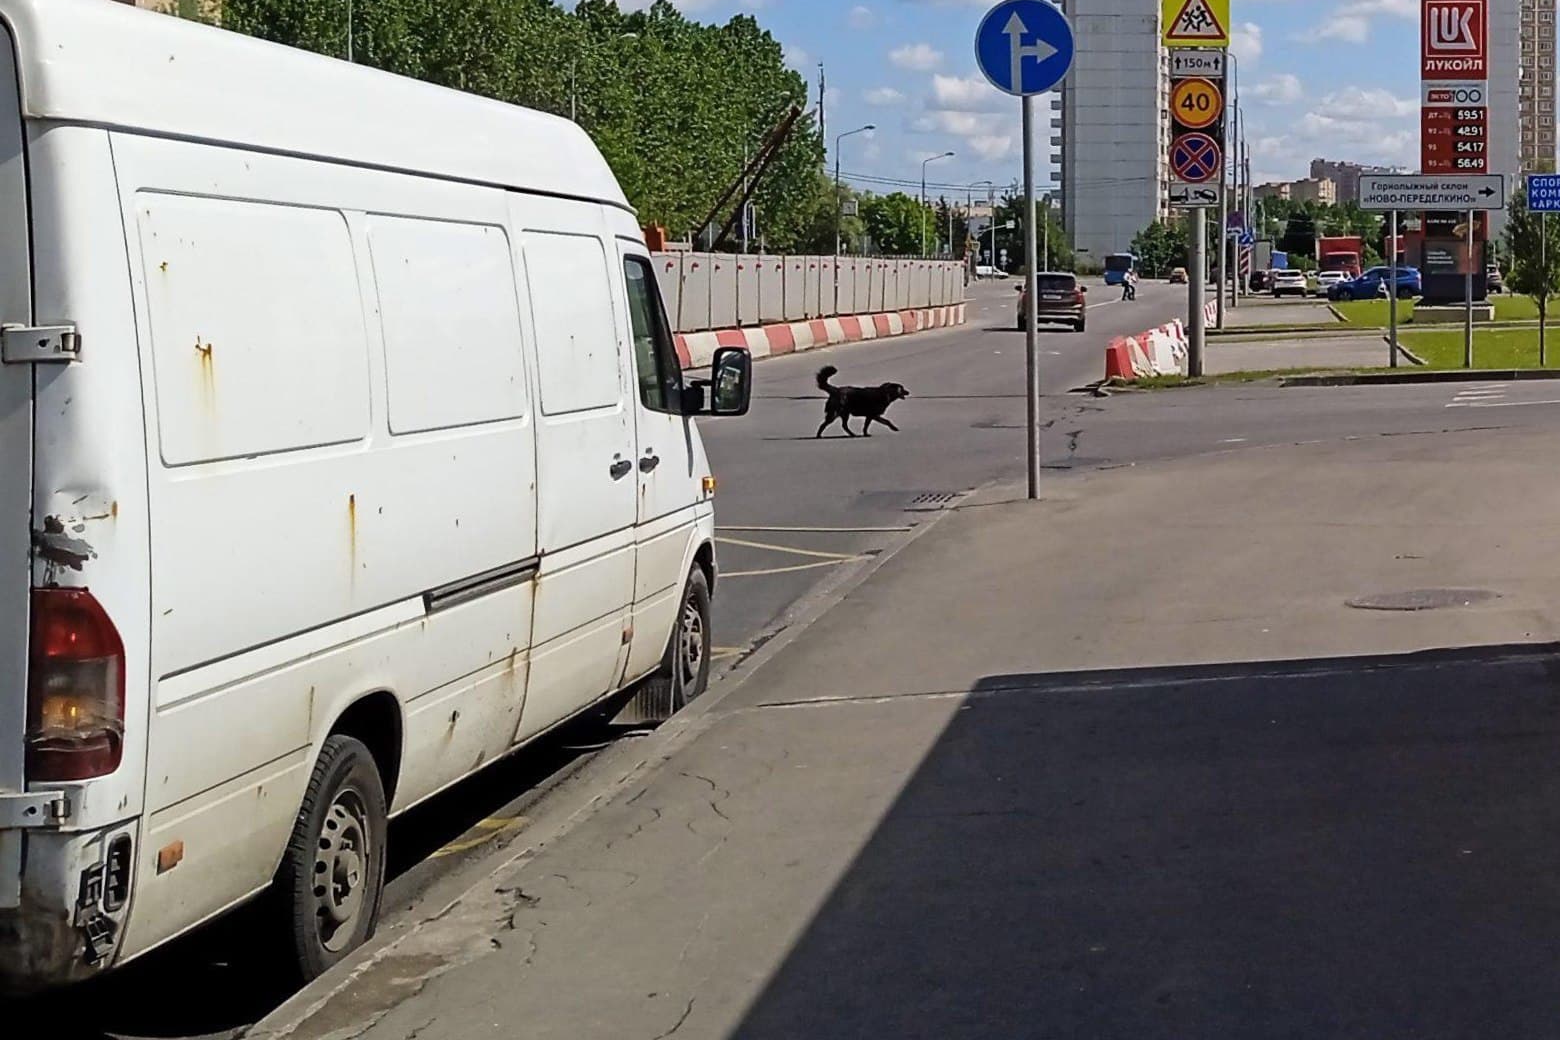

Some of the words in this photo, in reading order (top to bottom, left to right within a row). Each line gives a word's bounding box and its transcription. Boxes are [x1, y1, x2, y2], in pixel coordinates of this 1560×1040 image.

[1425, 58, 1483, 71] ЛУКОЙЛ
[1181, 93, 1210, 111] 40
[1450, 89, 1481, 103] 100
[1371, 181, 1439, 192] Горнолыжный
[1441, 182, 1468, 191] склон
[1363, 193, 1476, 204] «НОВО-ПЕРЕДЕЛКИНО»
